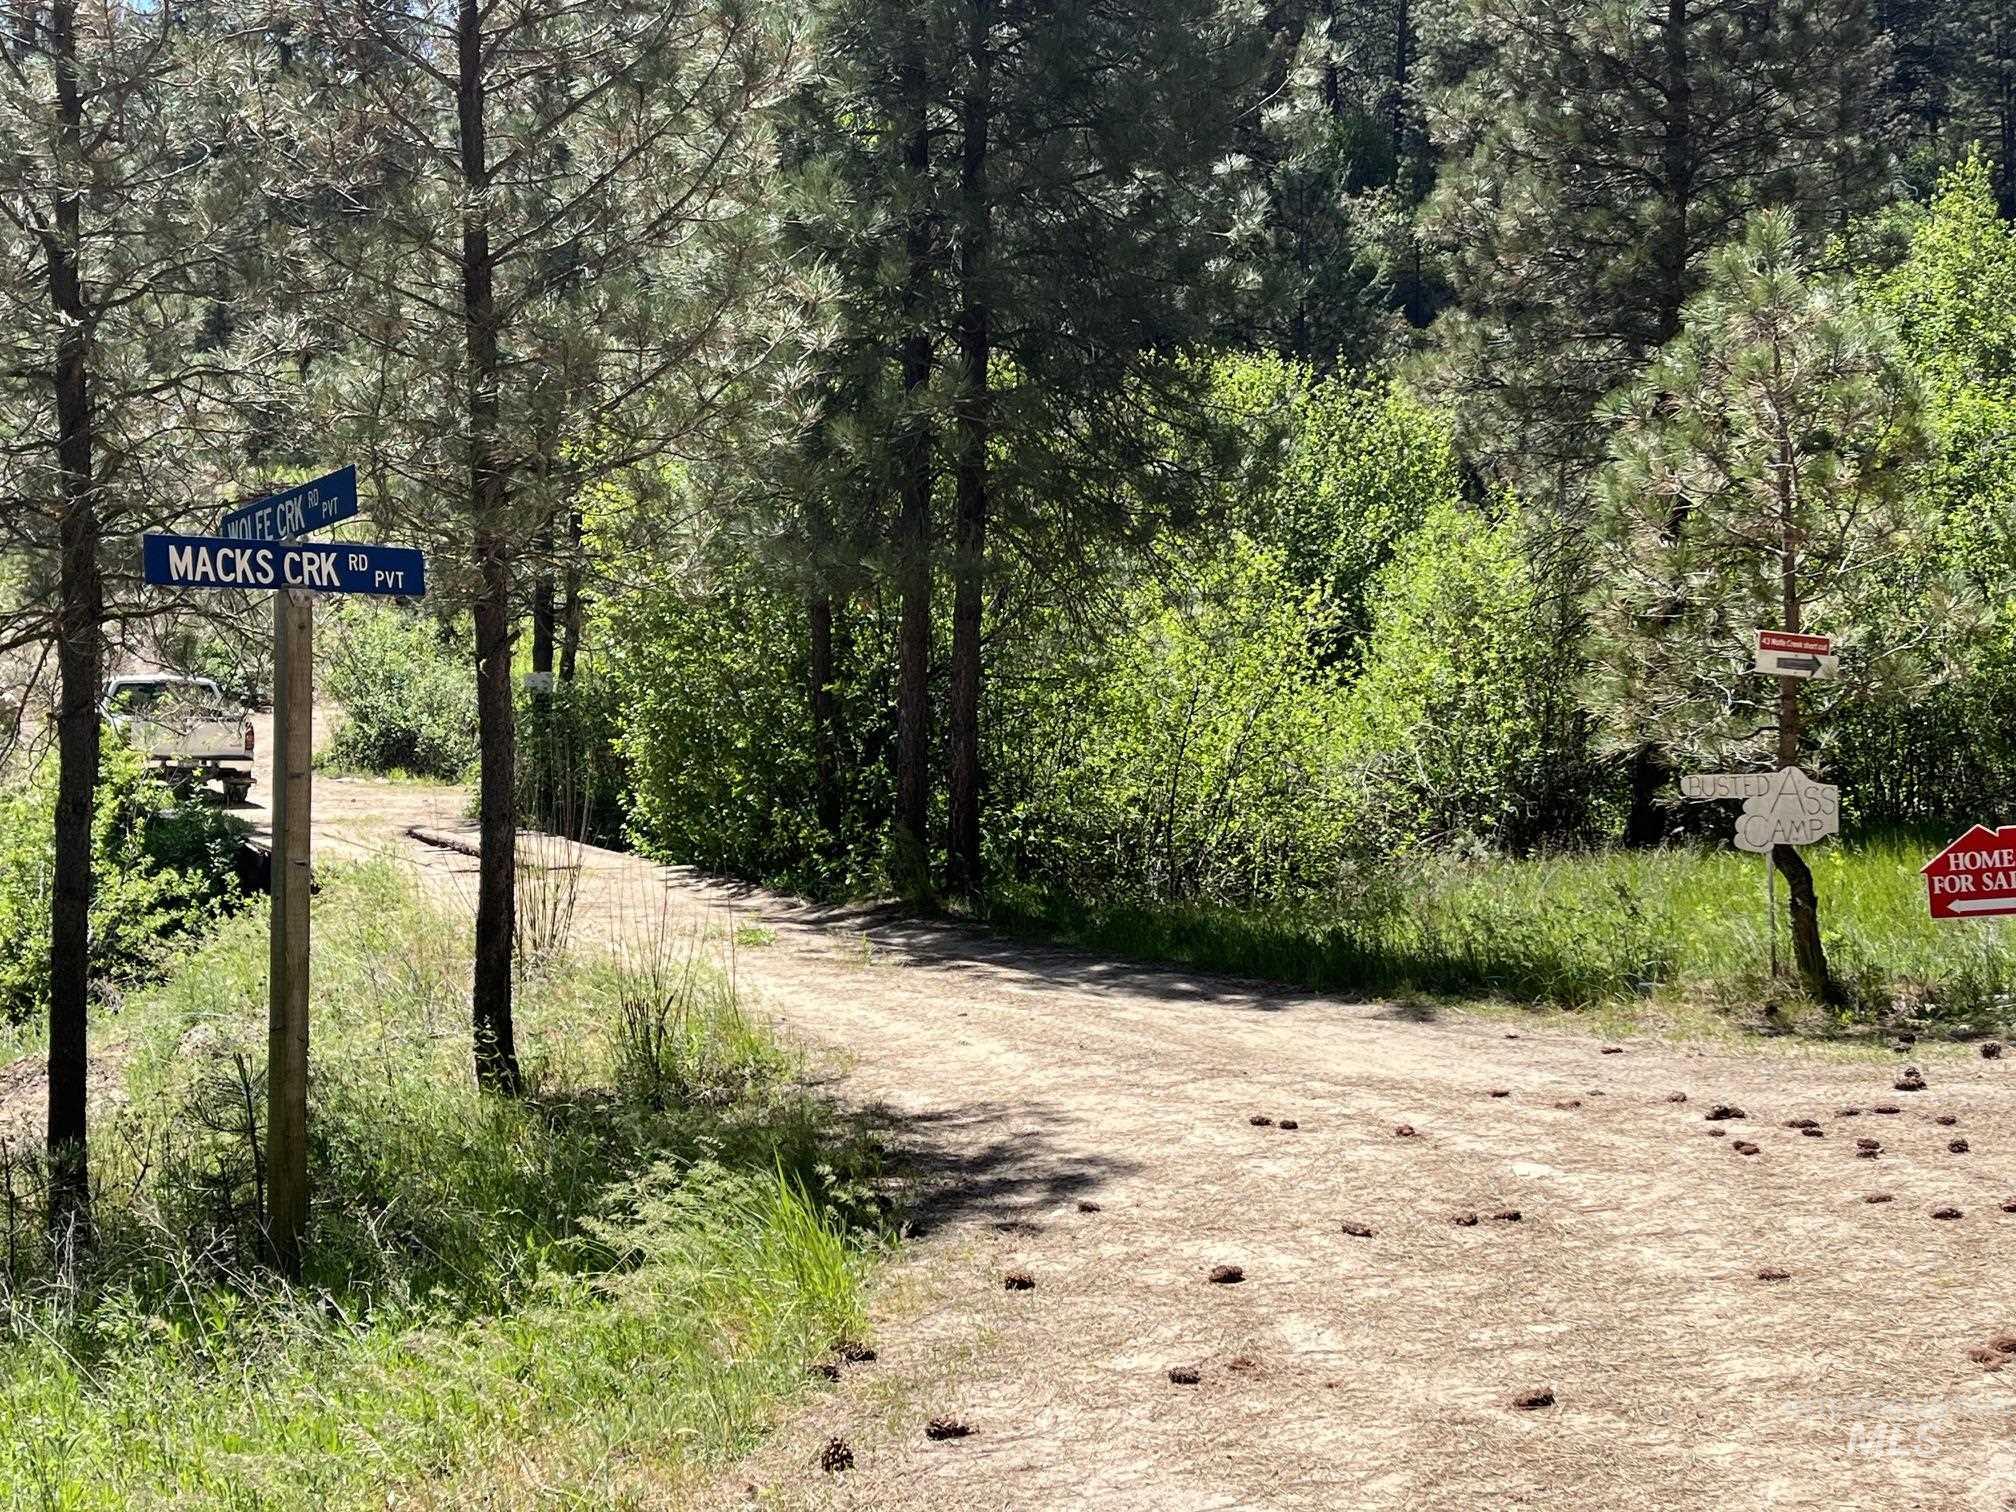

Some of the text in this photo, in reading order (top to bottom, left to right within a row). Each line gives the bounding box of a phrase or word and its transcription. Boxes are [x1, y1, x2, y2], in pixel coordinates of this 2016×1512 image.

[227, 488, 338, 540] WOLFE CRK RD PVT
[168, 545, 404, 589] MACKS CRK RD PVT
[1688, 775, 1770, 797] BUSTED
[1744, 814, 1824, 847] CAMP
[1947, 848, 2016, 871] HOME
[1932, 874, 1976, 894] FOR
